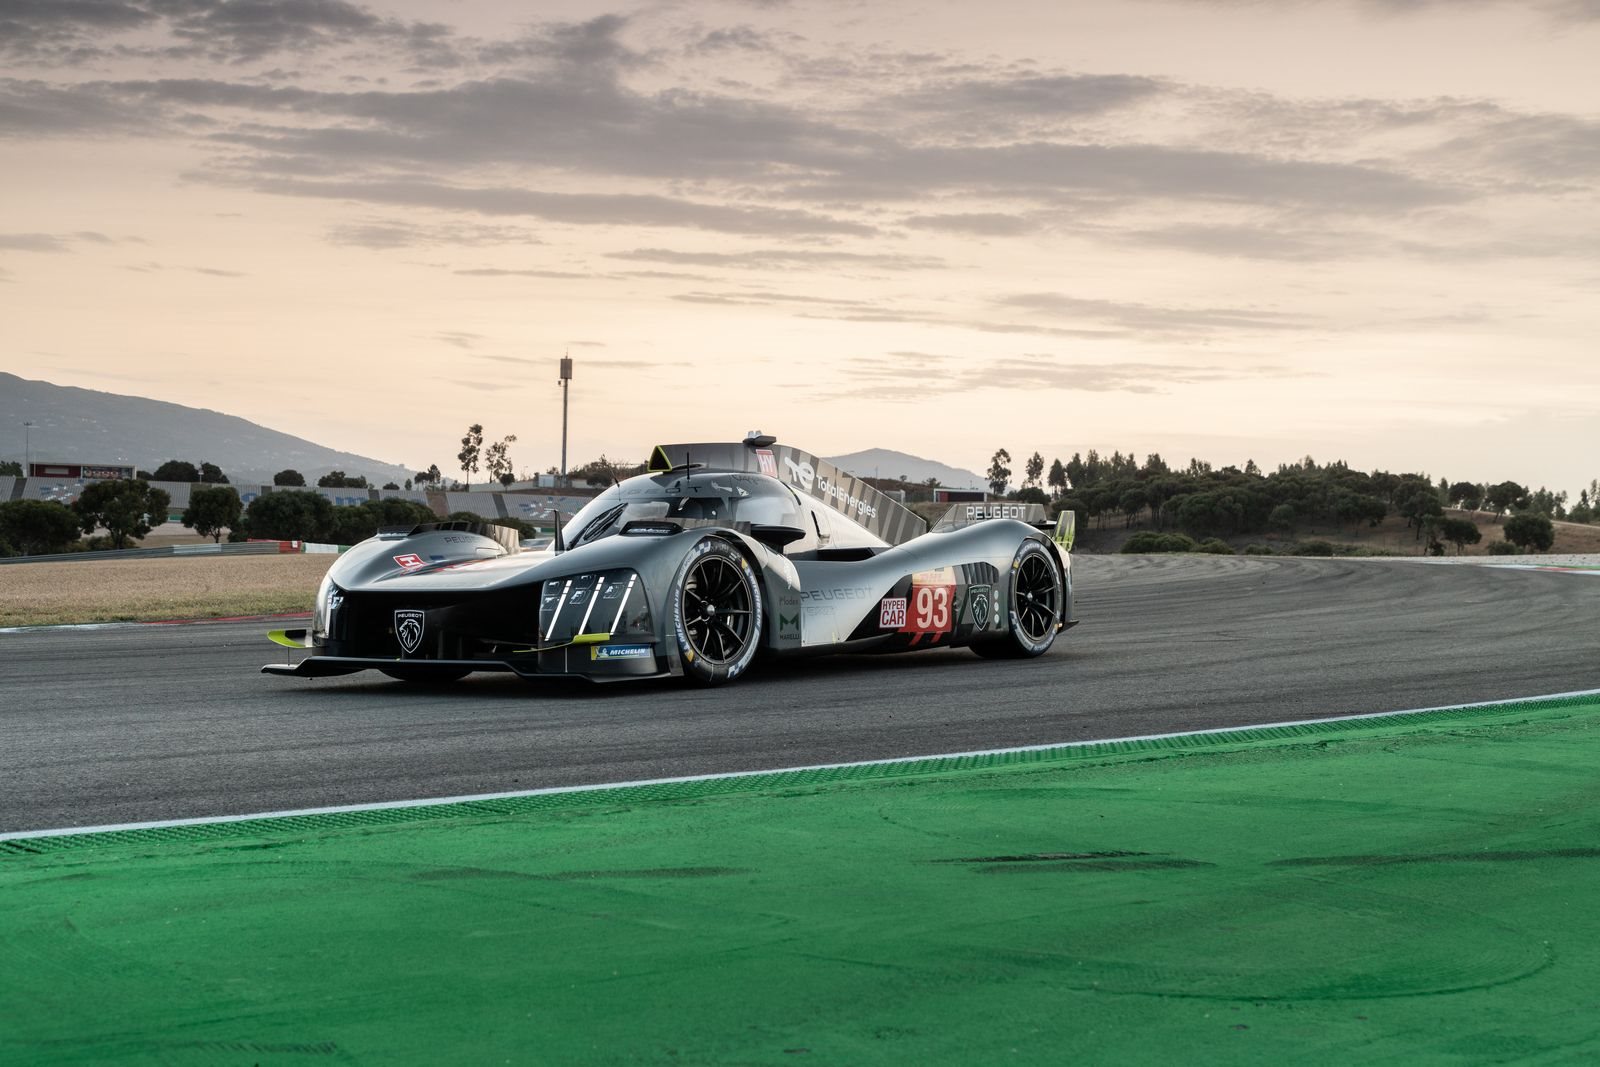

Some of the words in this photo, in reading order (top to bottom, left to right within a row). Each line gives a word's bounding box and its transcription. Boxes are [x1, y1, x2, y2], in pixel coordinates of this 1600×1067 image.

[816, 475, 877, 518] TotalEnergies
[966, 506, 1026, 519] PEUGEOT
[800, 586, 873, 602] PEUGEOT
[882, 600, 905, 610] HYPER
[916, 587, 948, 629] 93
[674, 589, 686, 643] MICHELIN
[881, 610, 905, 625] CAR
[609, 648, 647, 656] MICHELIN
